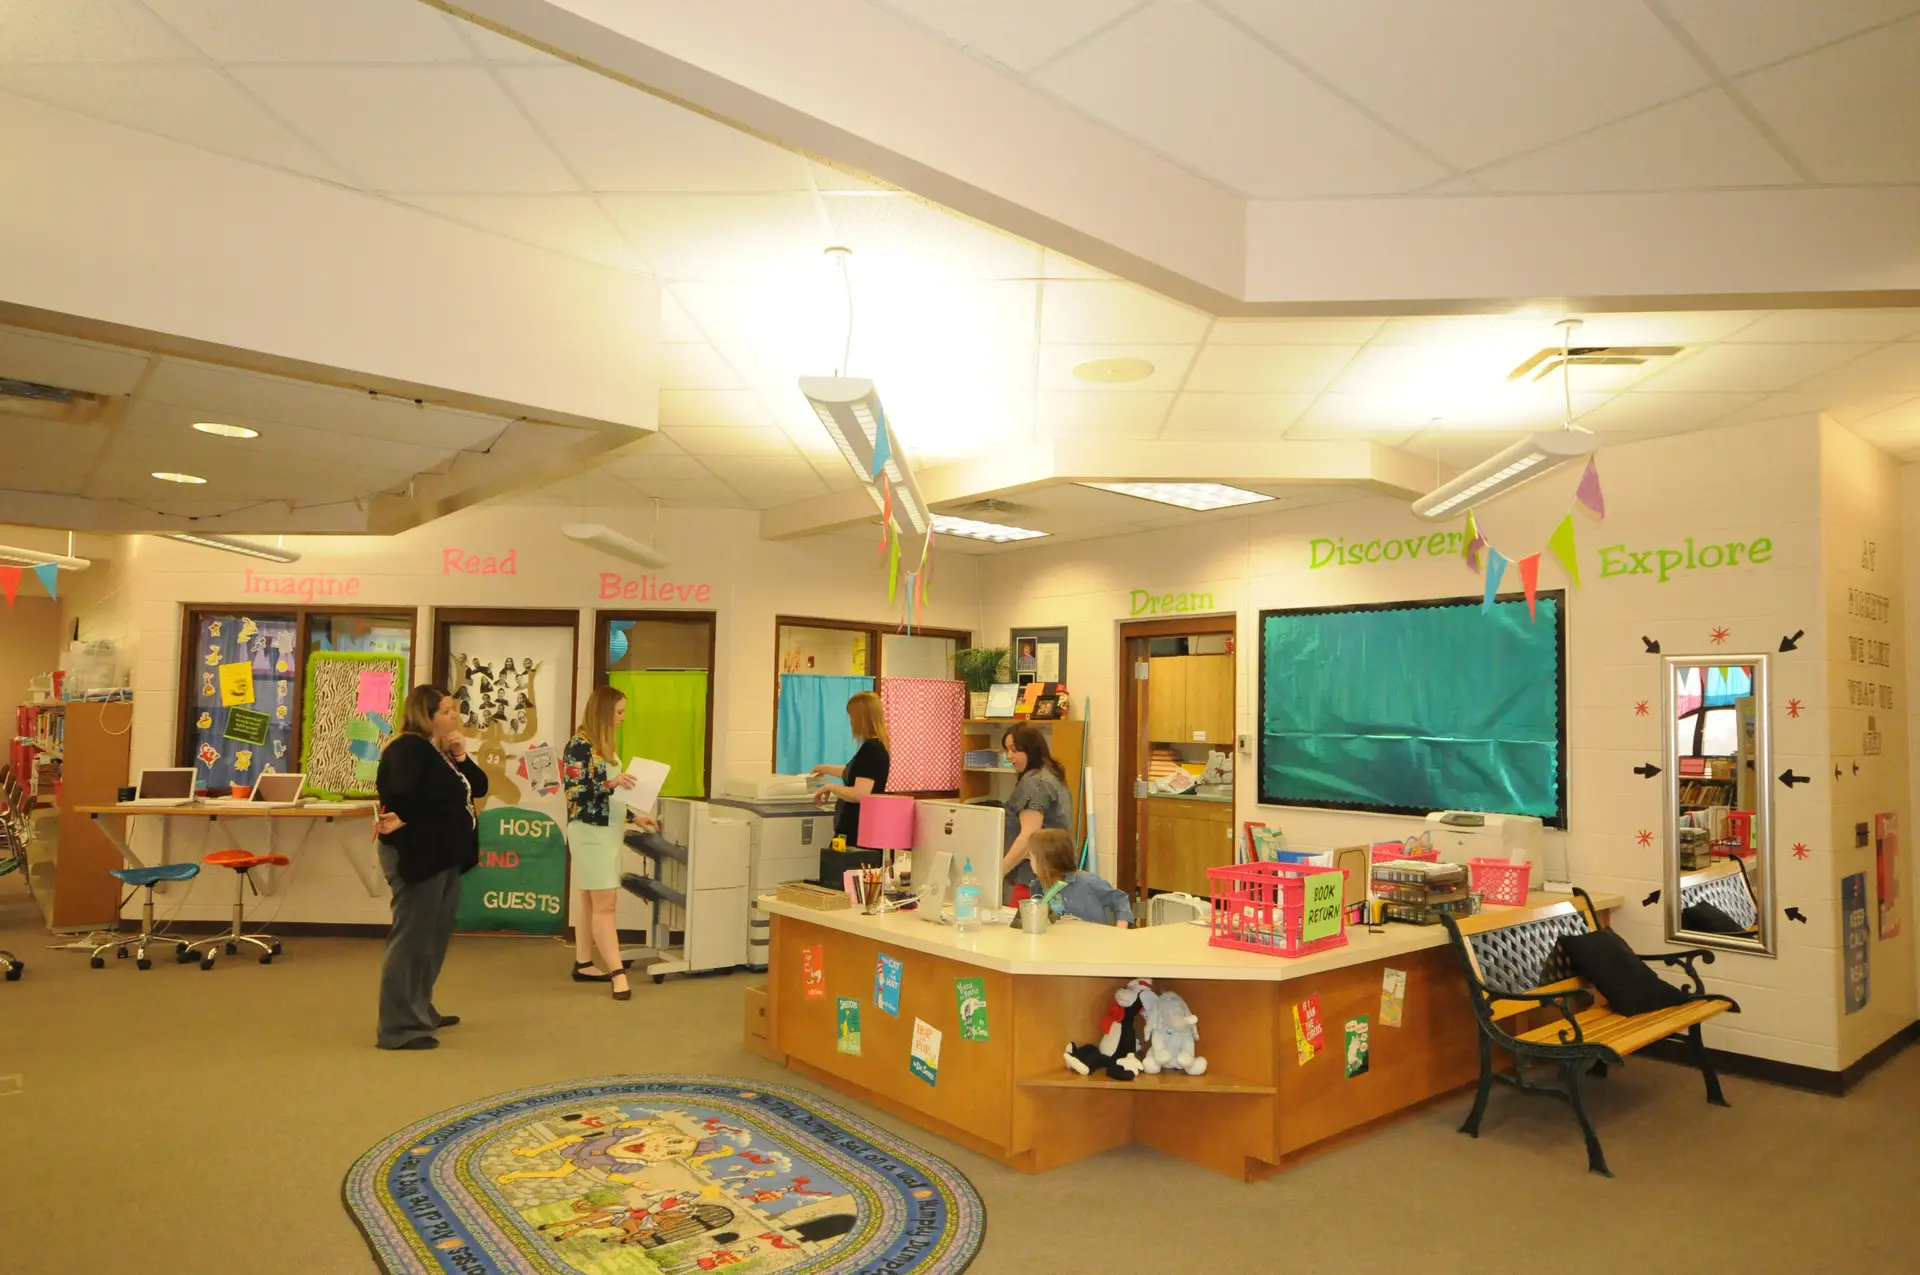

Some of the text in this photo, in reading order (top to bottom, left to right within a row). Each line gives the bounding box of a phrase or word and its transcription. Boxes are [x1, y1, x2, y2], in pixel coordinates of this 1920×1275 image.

[442, 548, 517, 575] Read
[1309, 531, 1463, 569] Discover
[1598, 537, 1773, 582] Explore
[244, 569, 360, 603] Imagine
[599, 573, 711, 603] Believe
[1130, 589, 1214, 616] Dream
[500, 819, 554, 837] HOST
[484, 891, 560, 914] GUESTS
[1314, 885, 1335, 902] BOOK
[1308, 904, 1341, 924] RETURN
[840, 1141, 872, 1154] sat
[864, 1154, 888, 1164] on
